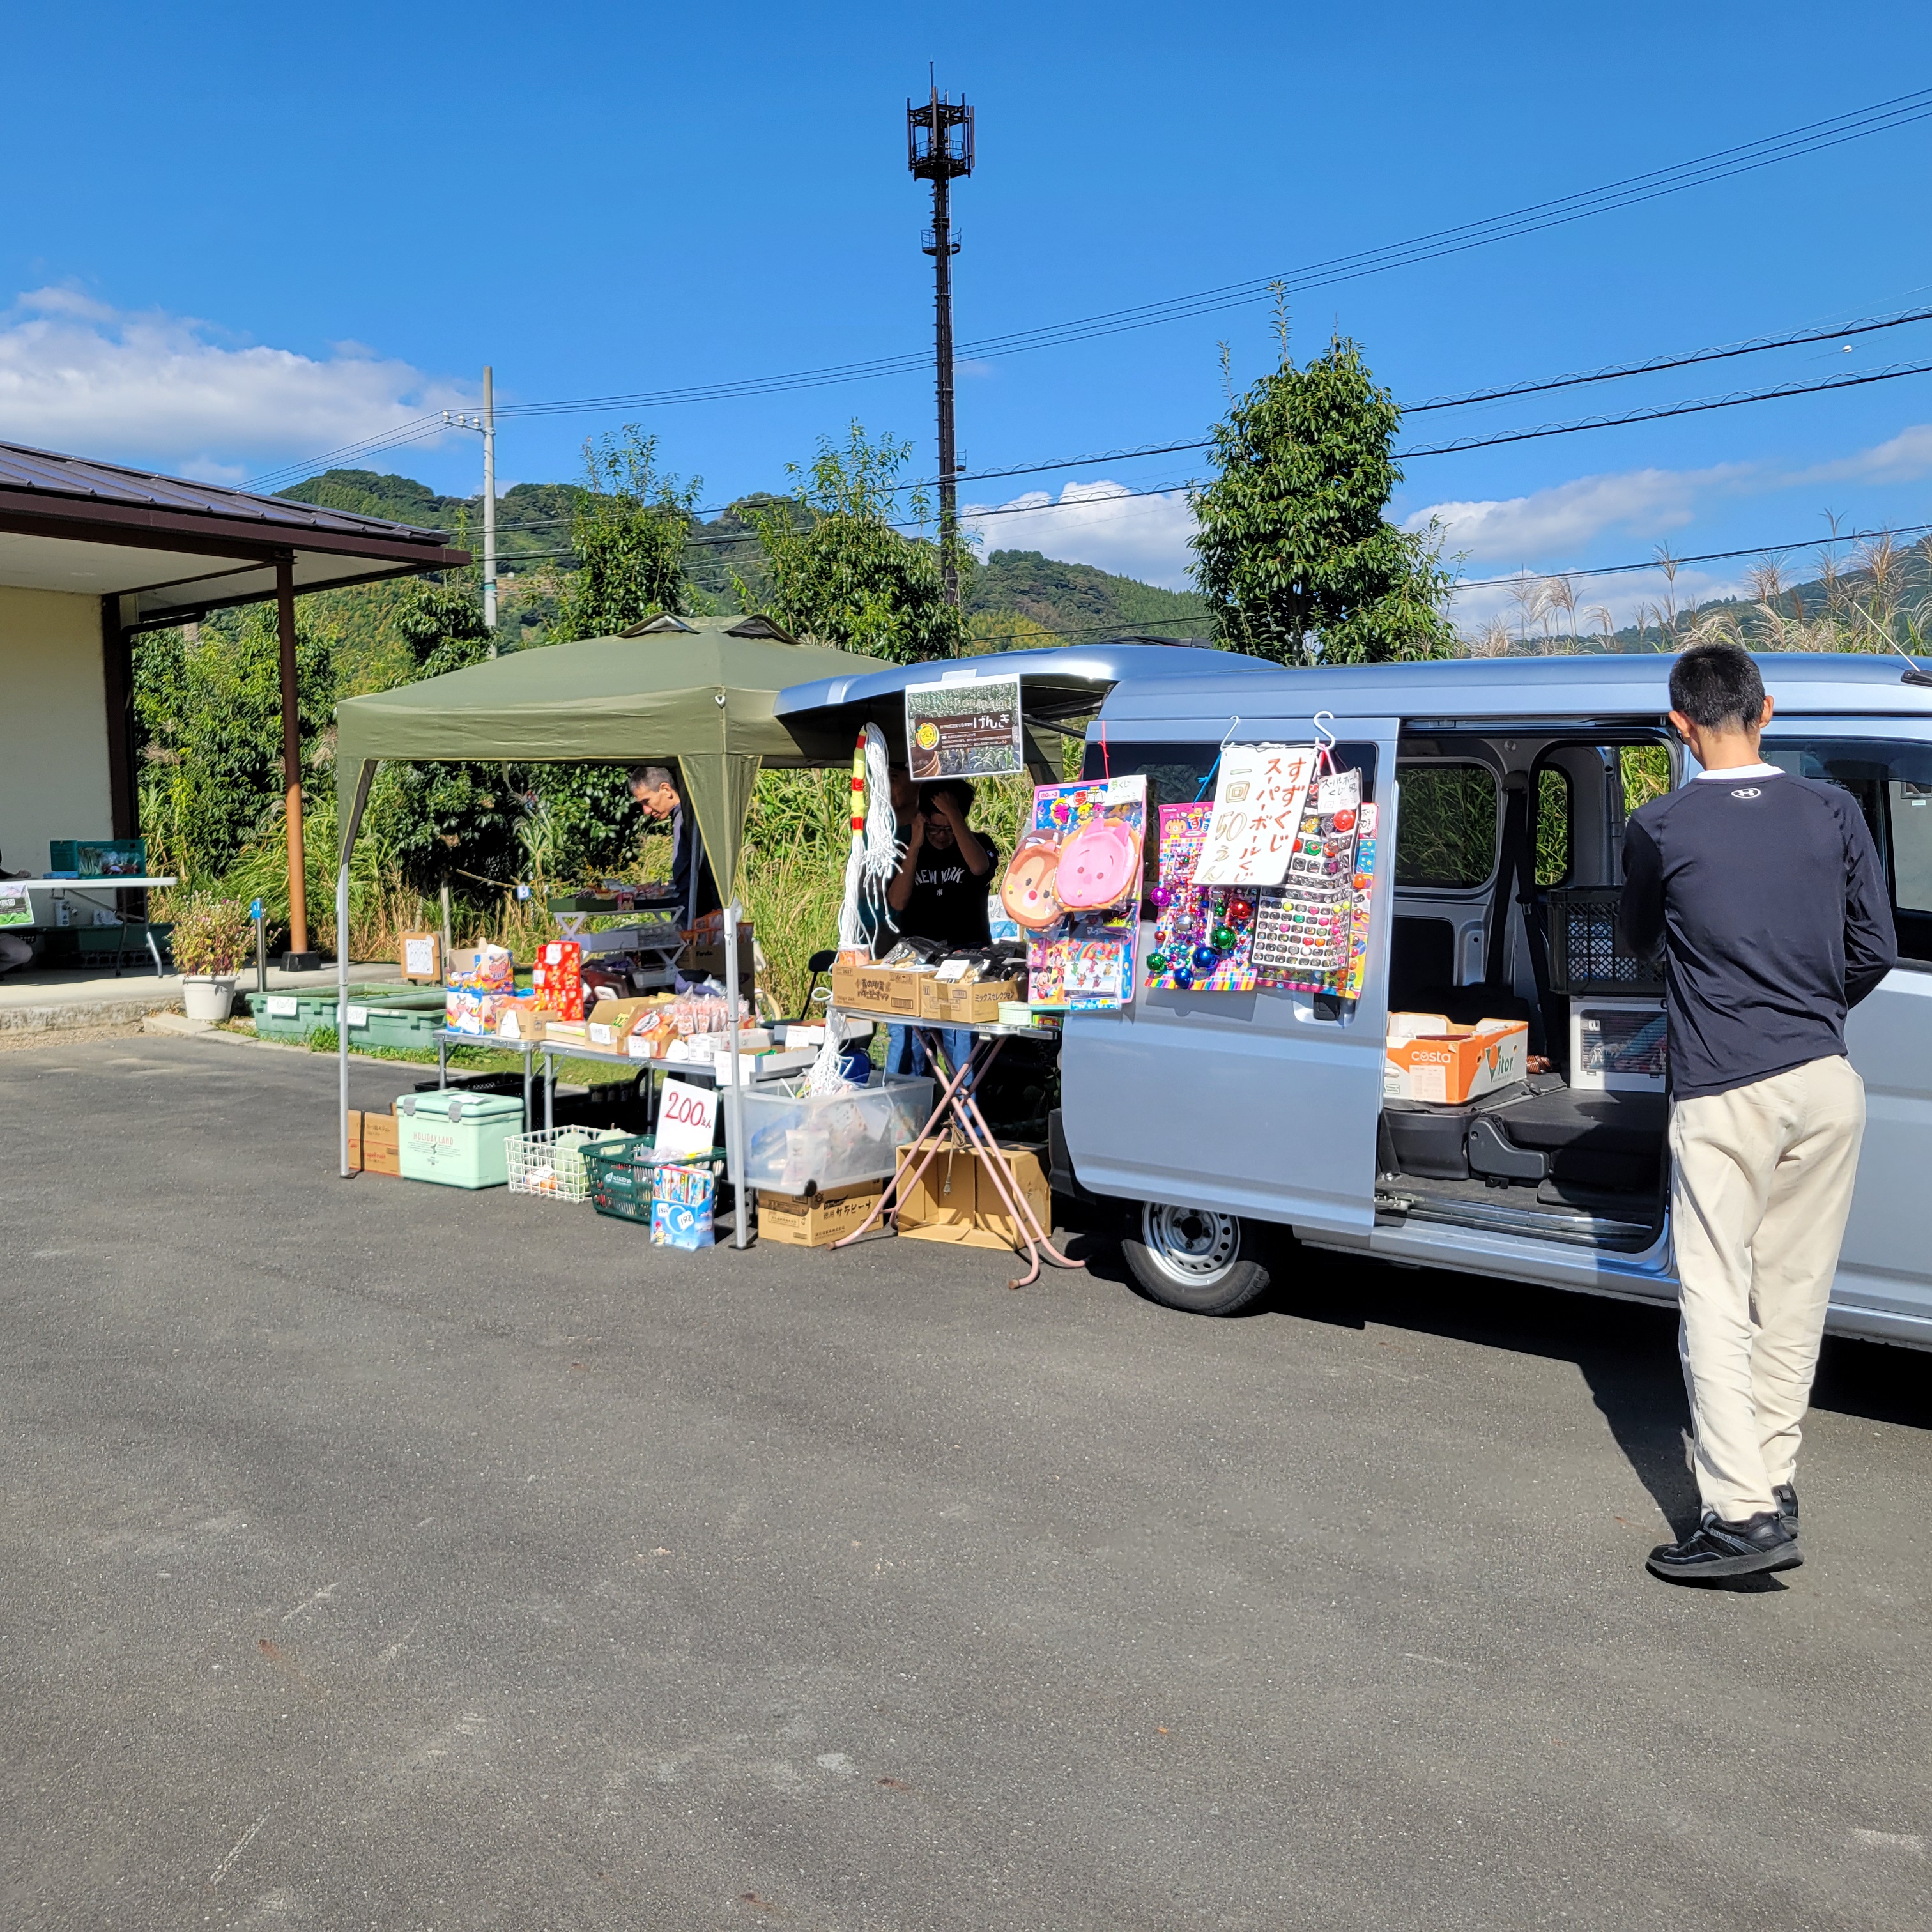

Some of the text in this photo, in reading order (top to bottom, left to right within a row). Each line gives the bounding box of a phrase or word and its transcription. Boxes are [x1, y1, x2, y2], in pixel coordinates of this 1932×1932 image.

[973, 713, 1010, 729] げんき
[1270, 756, 1307, 852] すずくじ
[1233, 758, 1282, 883] スーパーボールくじ
[914, 866, 965, 886] NEW YORK
[974, 990, 1015, 1002] ミックスセレクション
[1411, 1050, 1451, 1064] costa
[1485, 1044, 1514, 1083] Vitor
[413, 1131, 454, 1146] HOLIDAY LAND
